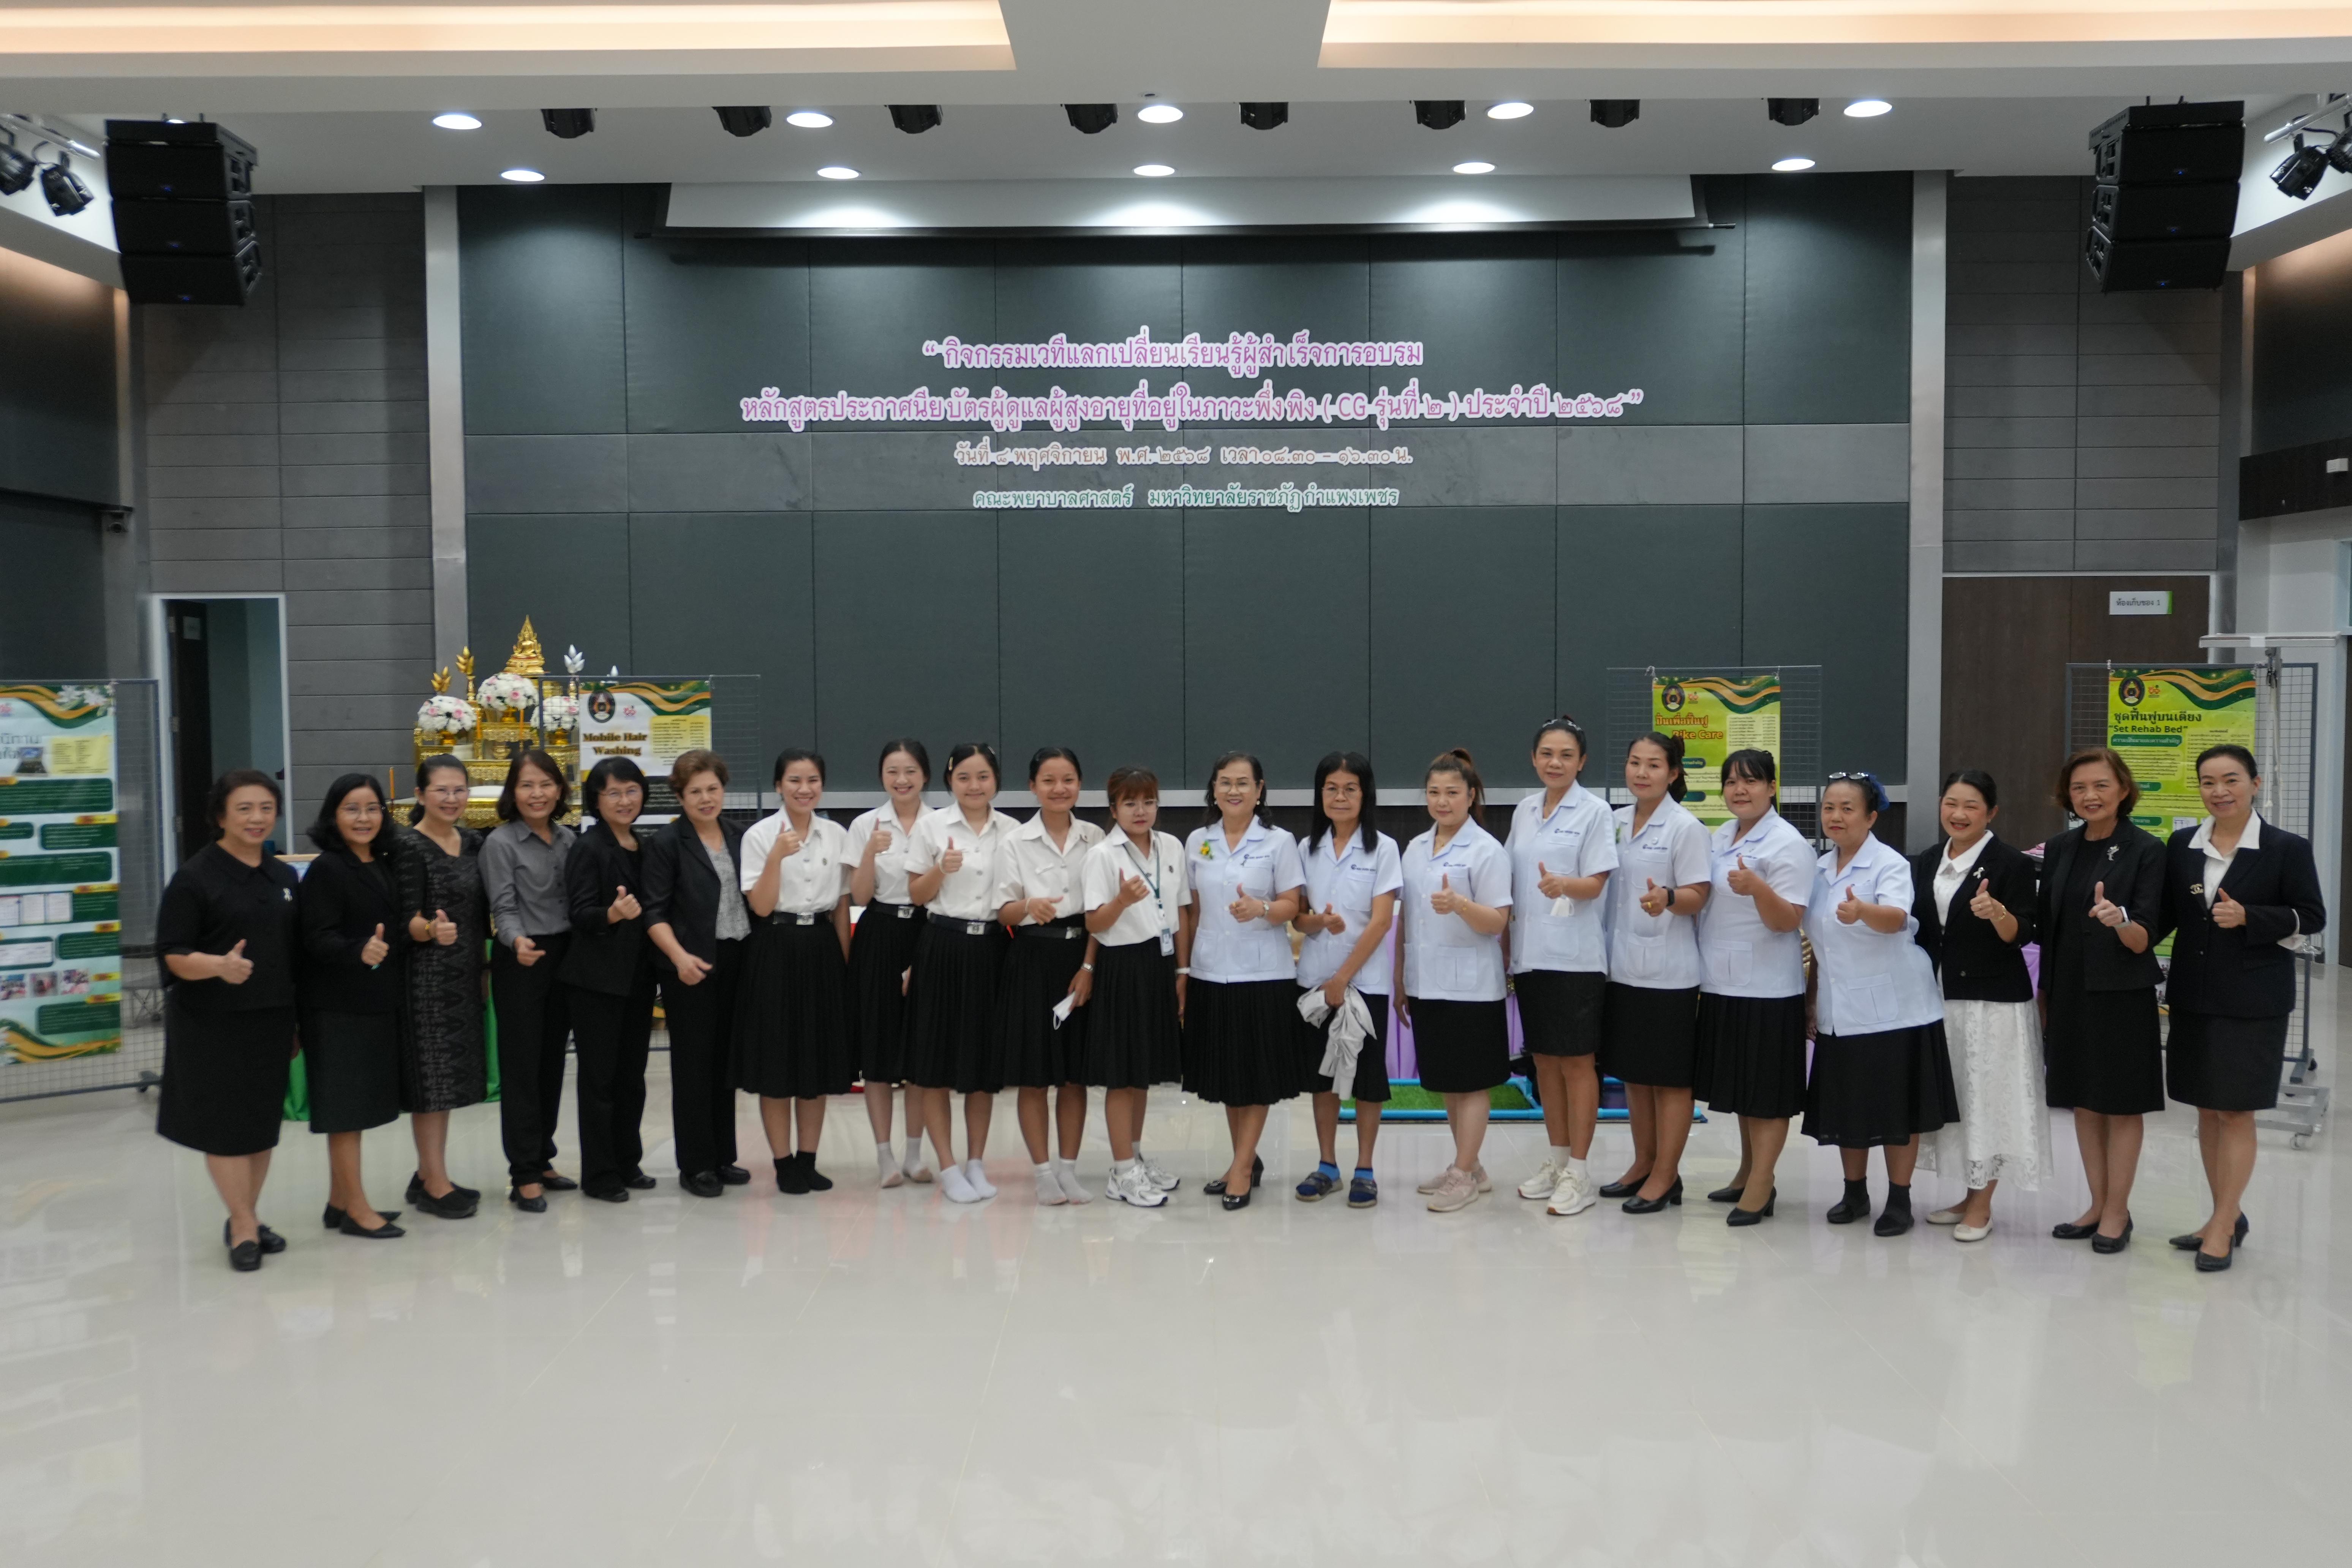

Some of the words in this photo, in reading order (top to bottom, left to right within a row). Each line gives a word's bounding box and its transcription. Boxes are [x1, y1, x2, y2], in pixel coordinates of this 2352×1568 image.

[1466, 386, 1549, 416] ประจำปี
[956, 437, 989, 463] วันที่
[1014, 444, 1106, 469] พฤศจิกายน
[1117, 447, 1152, 463] พ.ศ.
[974, 484, 1133, 507] คณะพยาบาลศาสตร์
[1149, 483, 1399, 511] มหาวิทยาลัยราชภัฏกำแพงเพชร
[2114, 707, 2202, 725] ชุดฟื้นฟูบนเตียง
[583, 732, 621, 741] Mobile
[623, 732, 648, 741] Hair
[1698, 730, 1724, 740] Care
[592, 745, 642, 756] Washing
